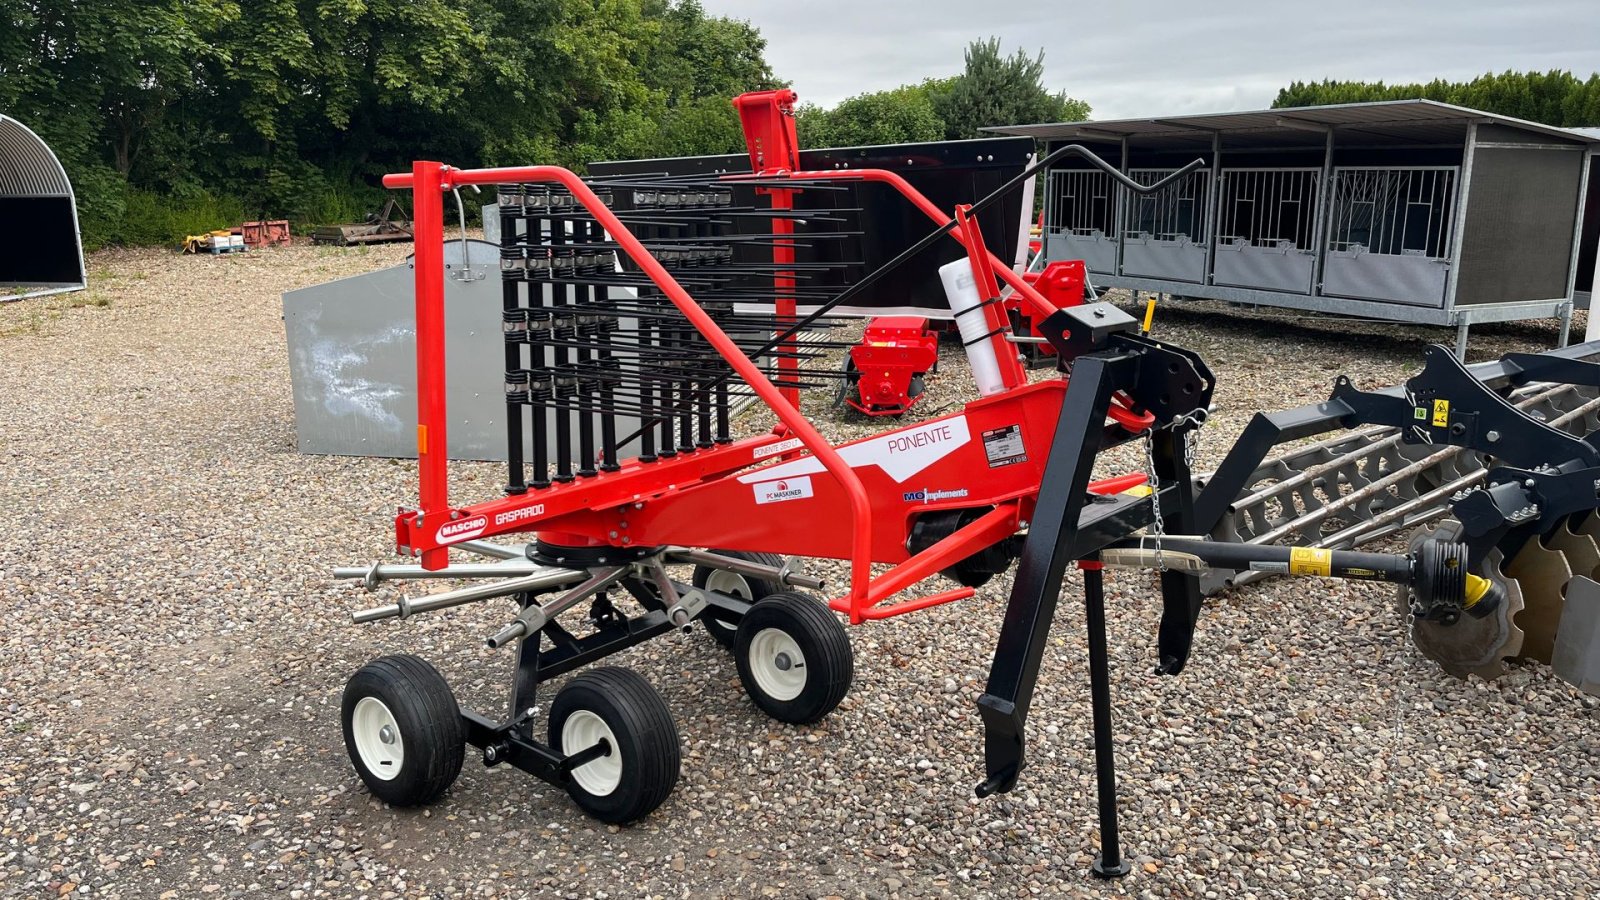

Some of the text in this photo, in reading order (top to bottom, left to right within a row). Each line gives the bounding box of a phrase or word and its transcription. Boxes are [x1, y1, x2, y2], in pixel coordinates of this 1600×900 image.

[888, 426, 952, 454] PONENTE
[754, 445, 779, 456] PONENTE
[773, 489, 802, 498] MASKINER
[442, 504, 545, 536] MASCHIO GASPARDO
